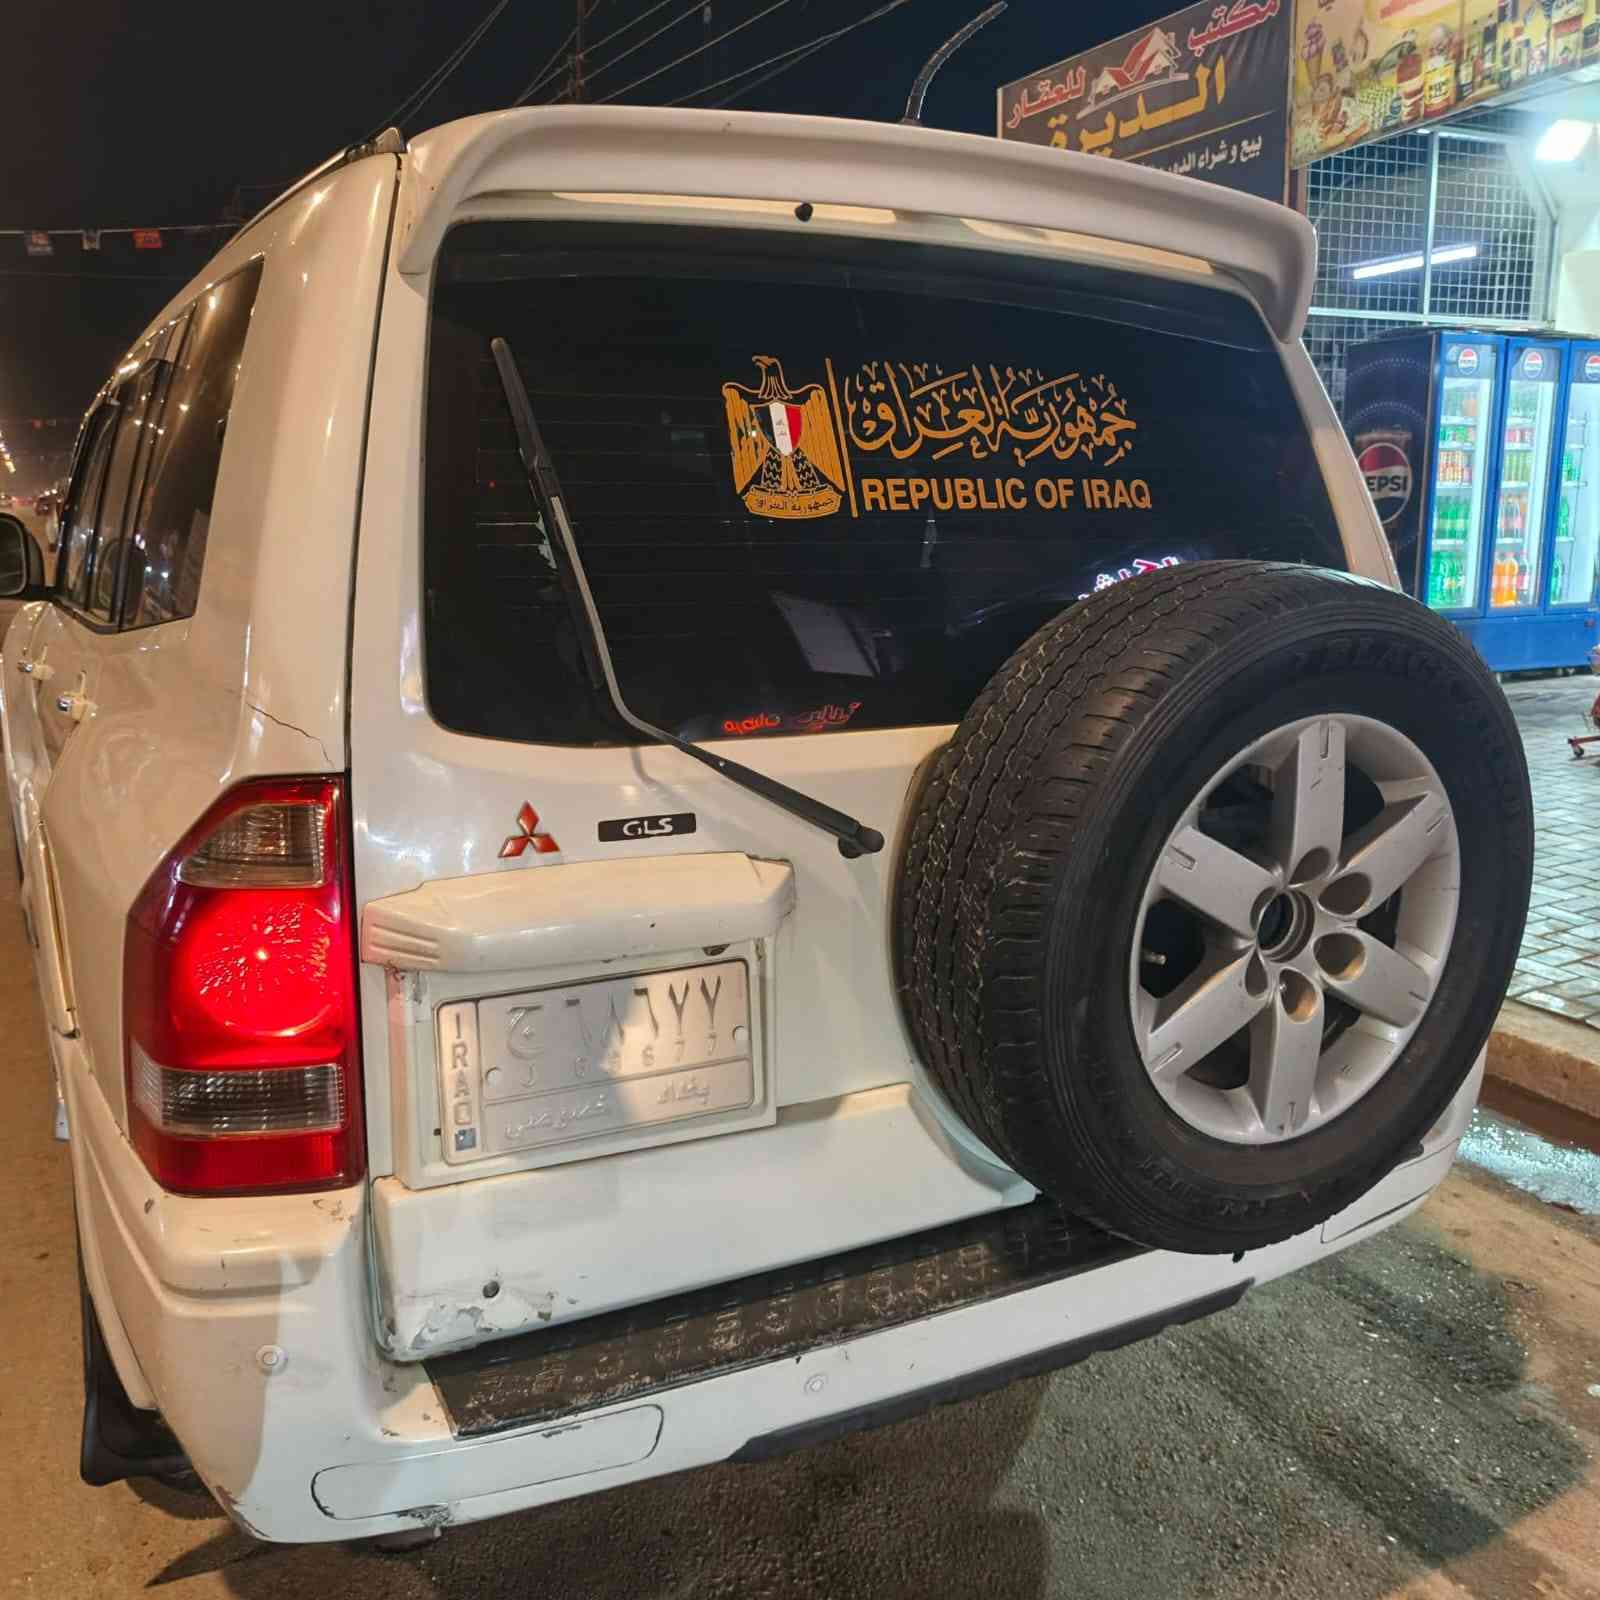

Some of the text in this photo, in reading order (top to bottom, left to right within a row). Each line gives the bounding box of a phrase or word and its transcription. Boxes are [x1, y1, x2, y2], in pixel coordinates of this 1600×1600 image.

[1006, 0, 1280, 129] مكتب للعقار
[1047, 55, 1227, 158] الديرة
[1239, 135, 1263, 162] بيع
[862, 477, 1152, 512] REPUBLIC OF IRAQ
[1367, 475, 1408, 493] EPSI
[623, 818, 673, 836] GLS
[450, 1012, 474, 1126] IRAQ
